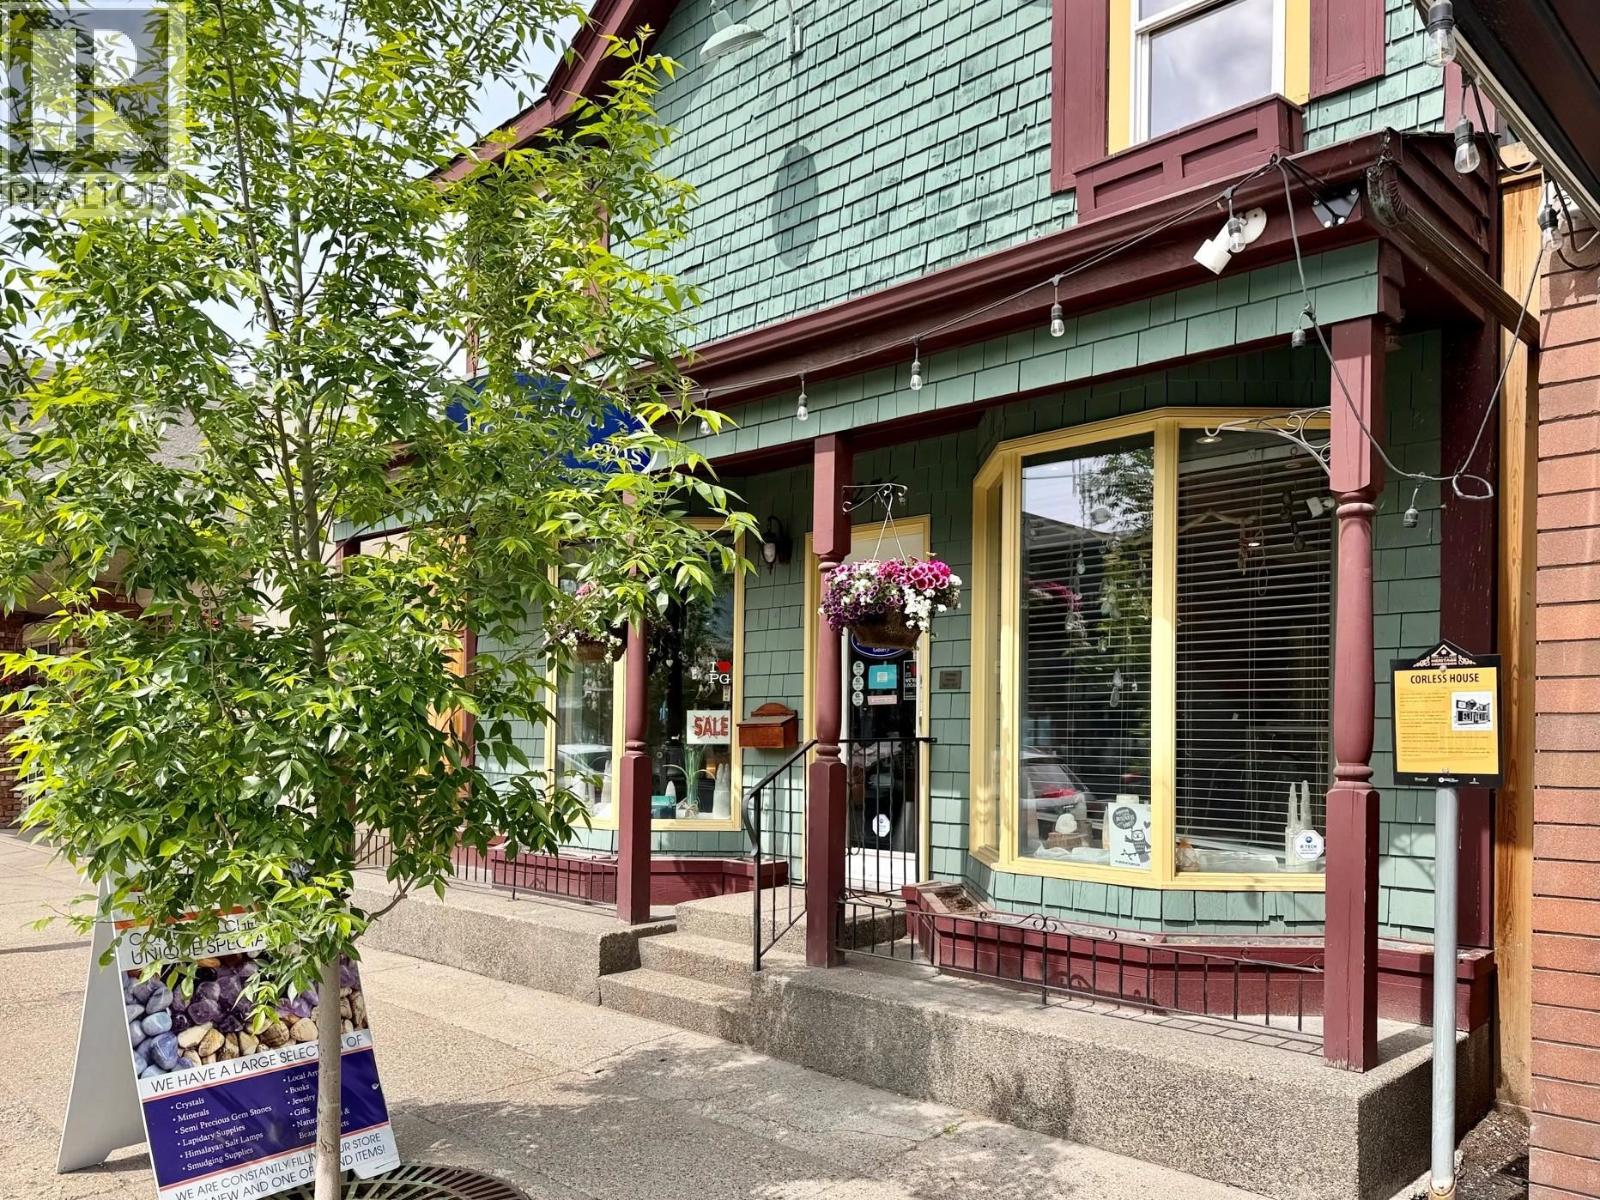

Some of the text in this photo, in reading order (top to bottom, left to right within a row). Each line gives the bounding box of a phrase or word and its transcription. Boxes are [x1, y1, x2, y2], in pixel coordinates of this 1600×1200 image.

[709, 673, 731, 684] PG
[1410, 673, 1480, 684] CORLESS HOUSE
[693, 715, 729, 738] SALE
[151, 1076, 174, 1092] WE
[178, 1067, 216, 1086] HAVE
[220, 1065, 231, 1075] A
[234, 1054, 277, 1074] LARGE
[346, 1034, 362, 1048] OF
[287, 1072, 306, 1083] Local
[290, 1083, 310, 1094] Books
[175, 1097, 205, 1110] Crystals
[291, 1093, 316, 1106] Jewelry
[177, 1108, 210, 1123] Minerals
[179, 1104, 273, 1135] Semi Precious Gem Stones
[293, 1106, 311, 1117] Gifts
[182, 1124, 246, 1147] Lapidary Supplies
[184, 1131, 264, 1159] Himalayan Salt Lamps
[176, 1189, 194, 1200] WE
[197, 1182, 218, 1198] ARE
[222, 1162, 291, 1189] CONSTANTLY
[352, 1132, 381, 1149] STORE
[187, 1146, 254, 1172] Smudging Supplies
[243, 1181, 269, 1198] AND
[271, 1172, 297, 1189] ONE
[356, 1145, 385, 1163] ITEMS!
